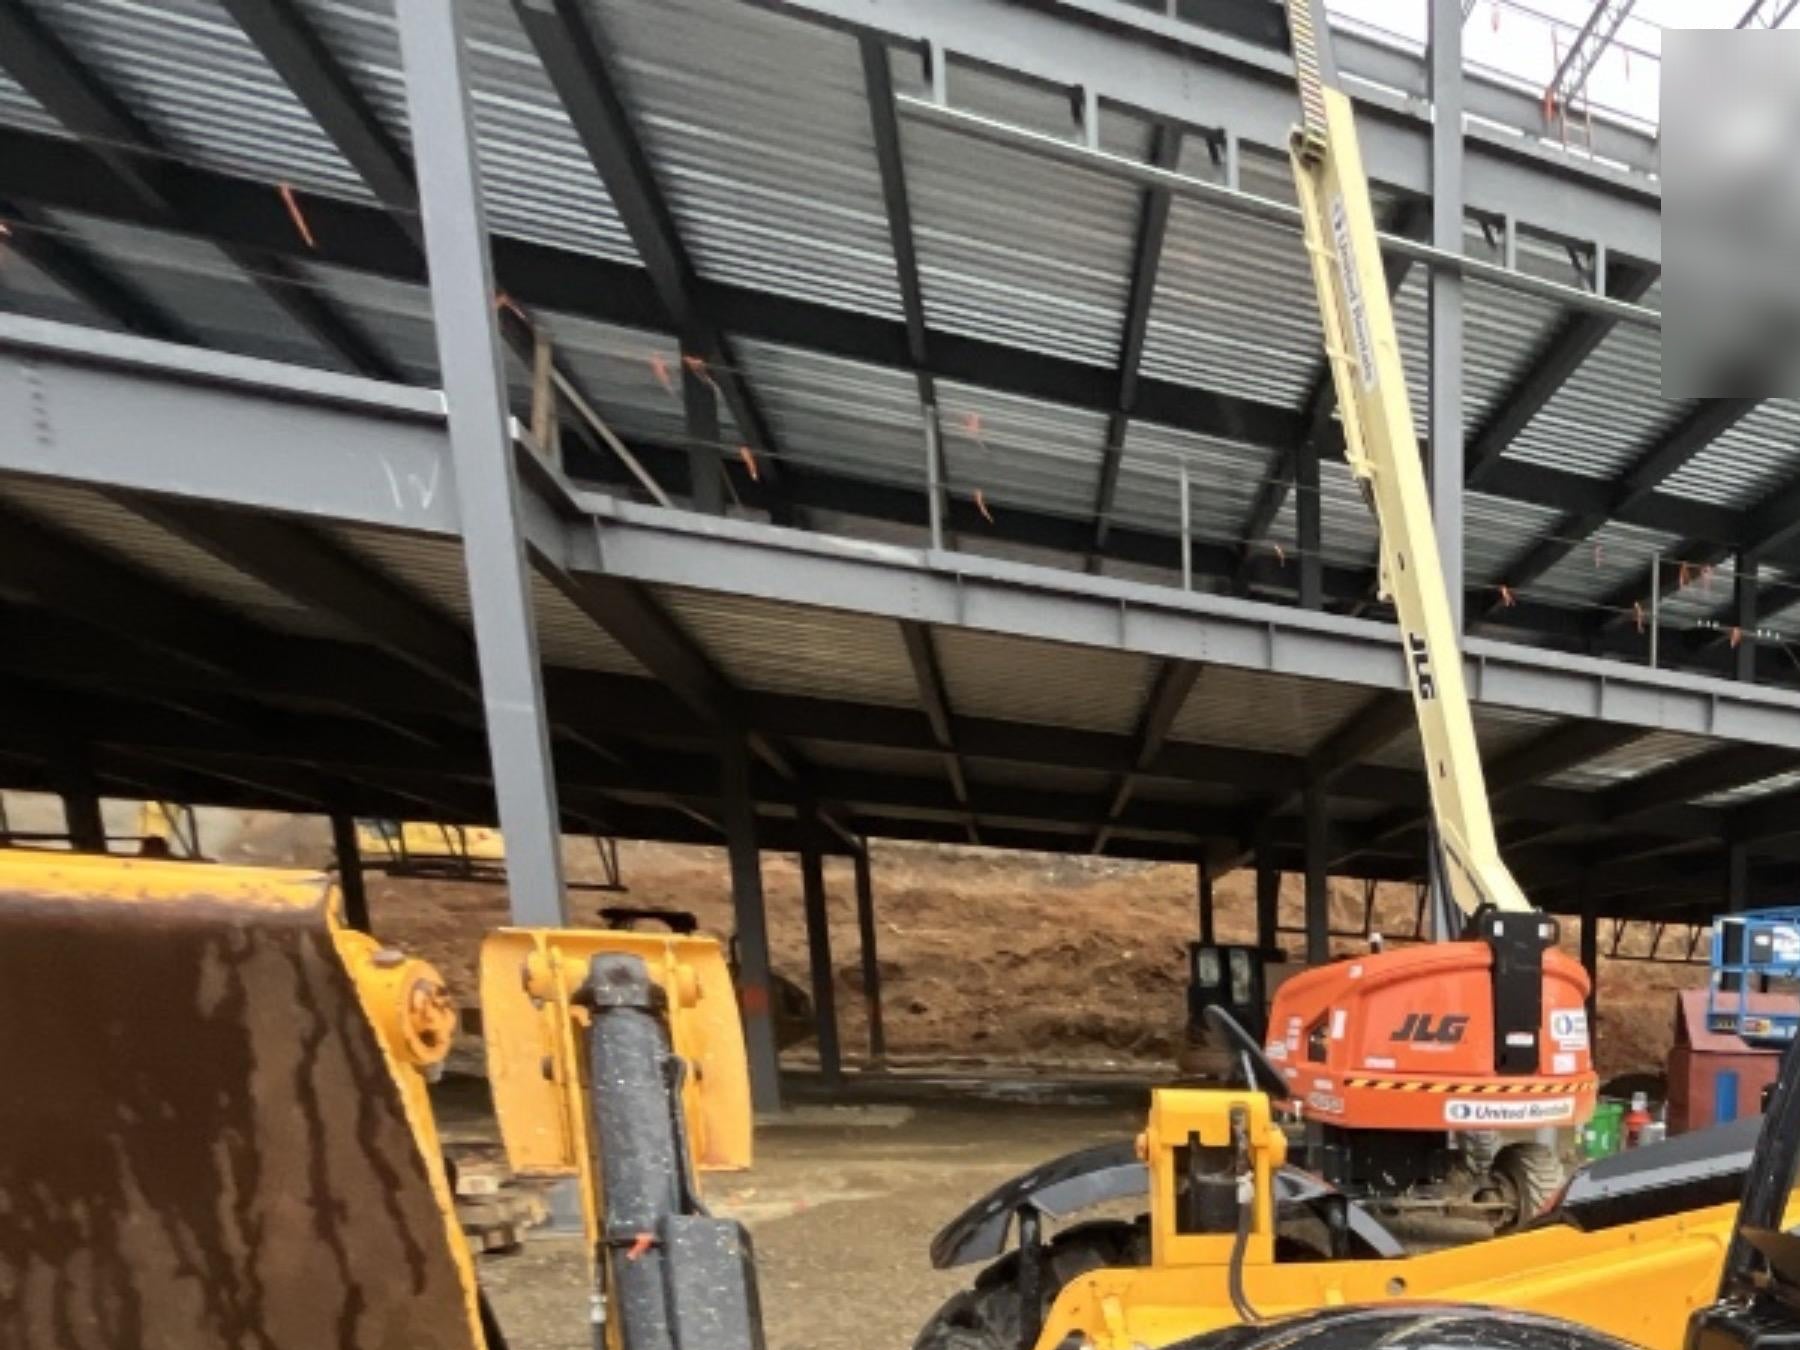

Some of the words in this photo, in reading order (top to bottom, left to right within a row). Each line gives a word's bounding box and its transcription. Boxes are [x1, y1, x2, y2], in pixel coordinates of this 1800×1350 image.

[1409, 632, 1434, 699] JLG
[1389, 1013, 1471, 1044] JLG
[1474, 1103, 1526, 1120] United
